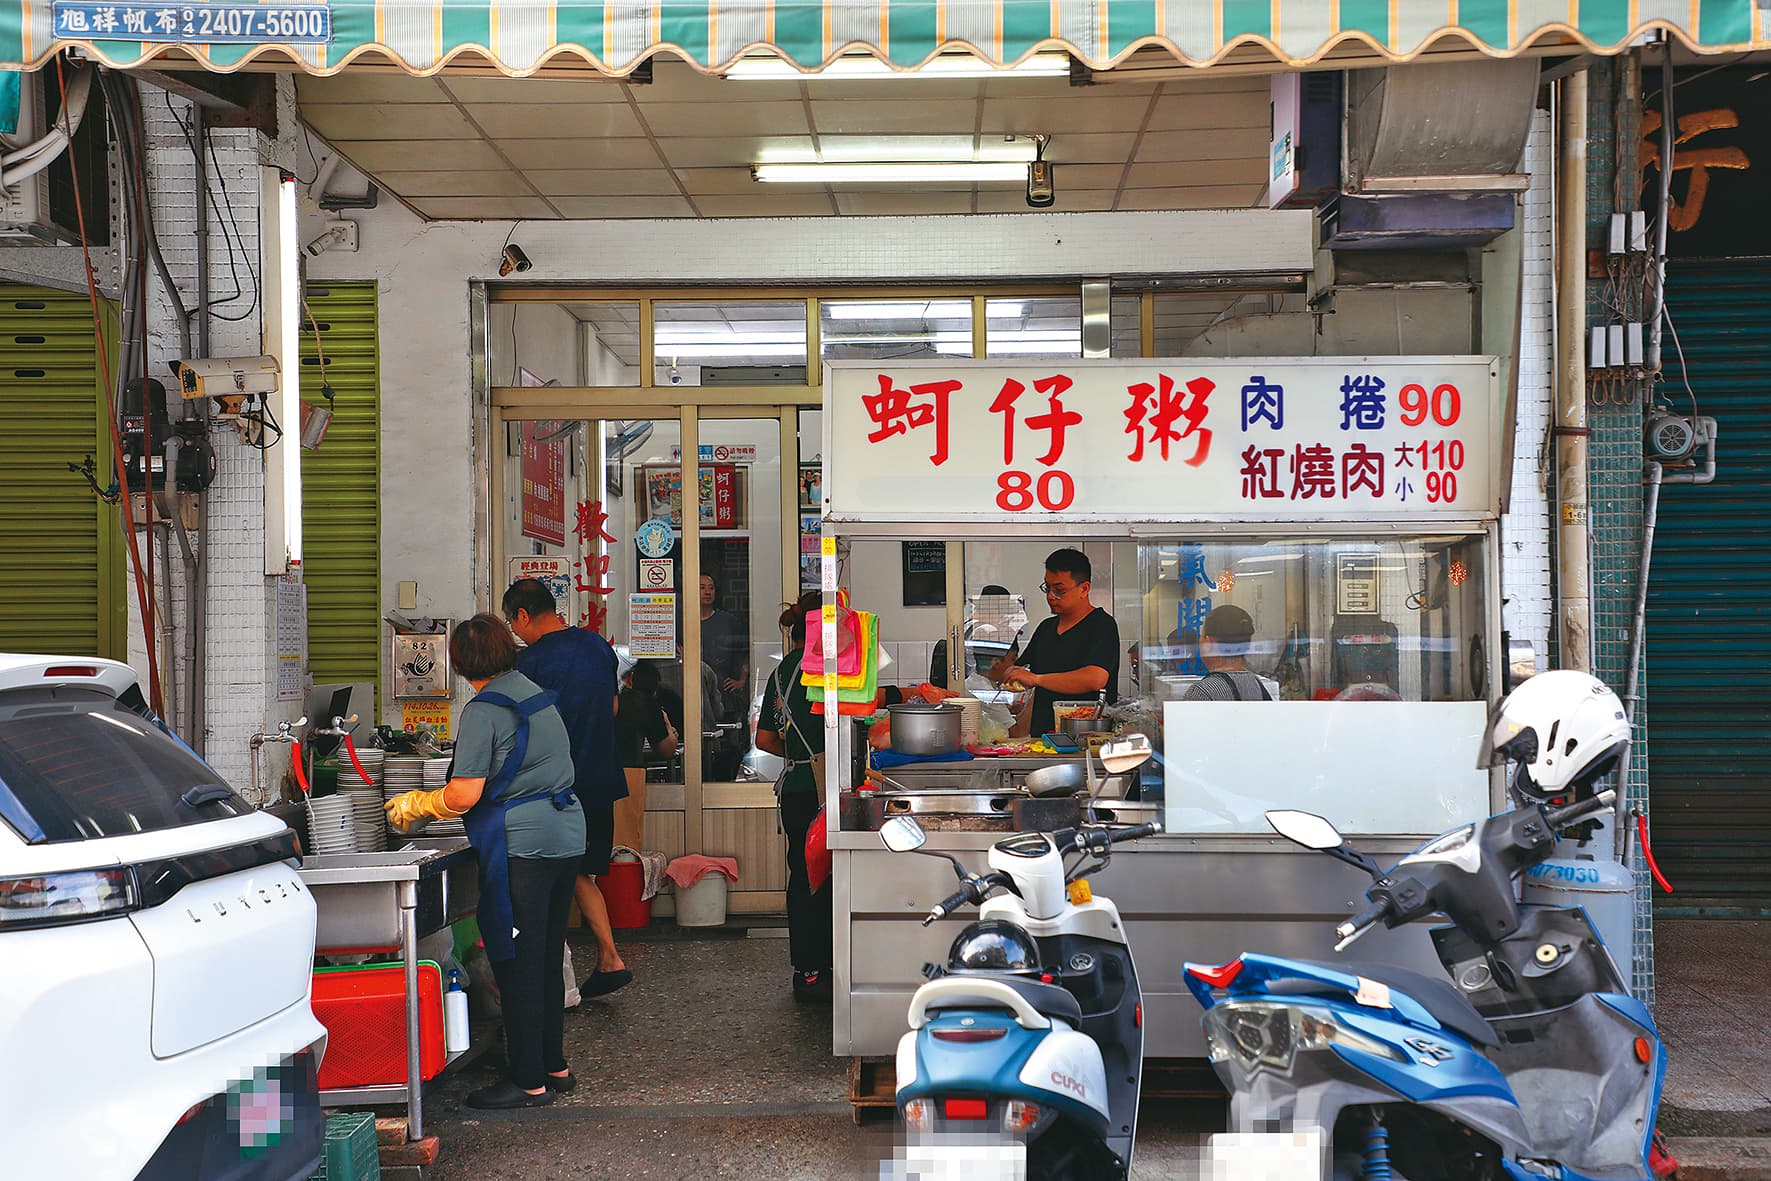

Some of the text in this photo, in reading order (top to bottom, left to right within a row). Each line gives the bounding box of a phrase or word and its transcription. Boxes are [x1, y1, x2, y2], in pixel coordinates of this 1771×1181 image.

[60, 7, 178, 35] 旭祥帆布
[199, 9, 323, 37] 2407-5600
[861, 373, 1217, 468] 蚵仔粥
[1240, 374, 1462, 432] 肉捲 90
[1240, 442, 1386, 501] 紅燒肉
[1394, 439, 1465, 471] 大 110
[716, 472, 731, 521] 蚵仔粥
[995, 470, 1075, 512] 80
[1394, 471, 1457, 503] 小 90
[411, 642, 428, 650] 82
[1050, 1071, 1087, 1098] CUXI
